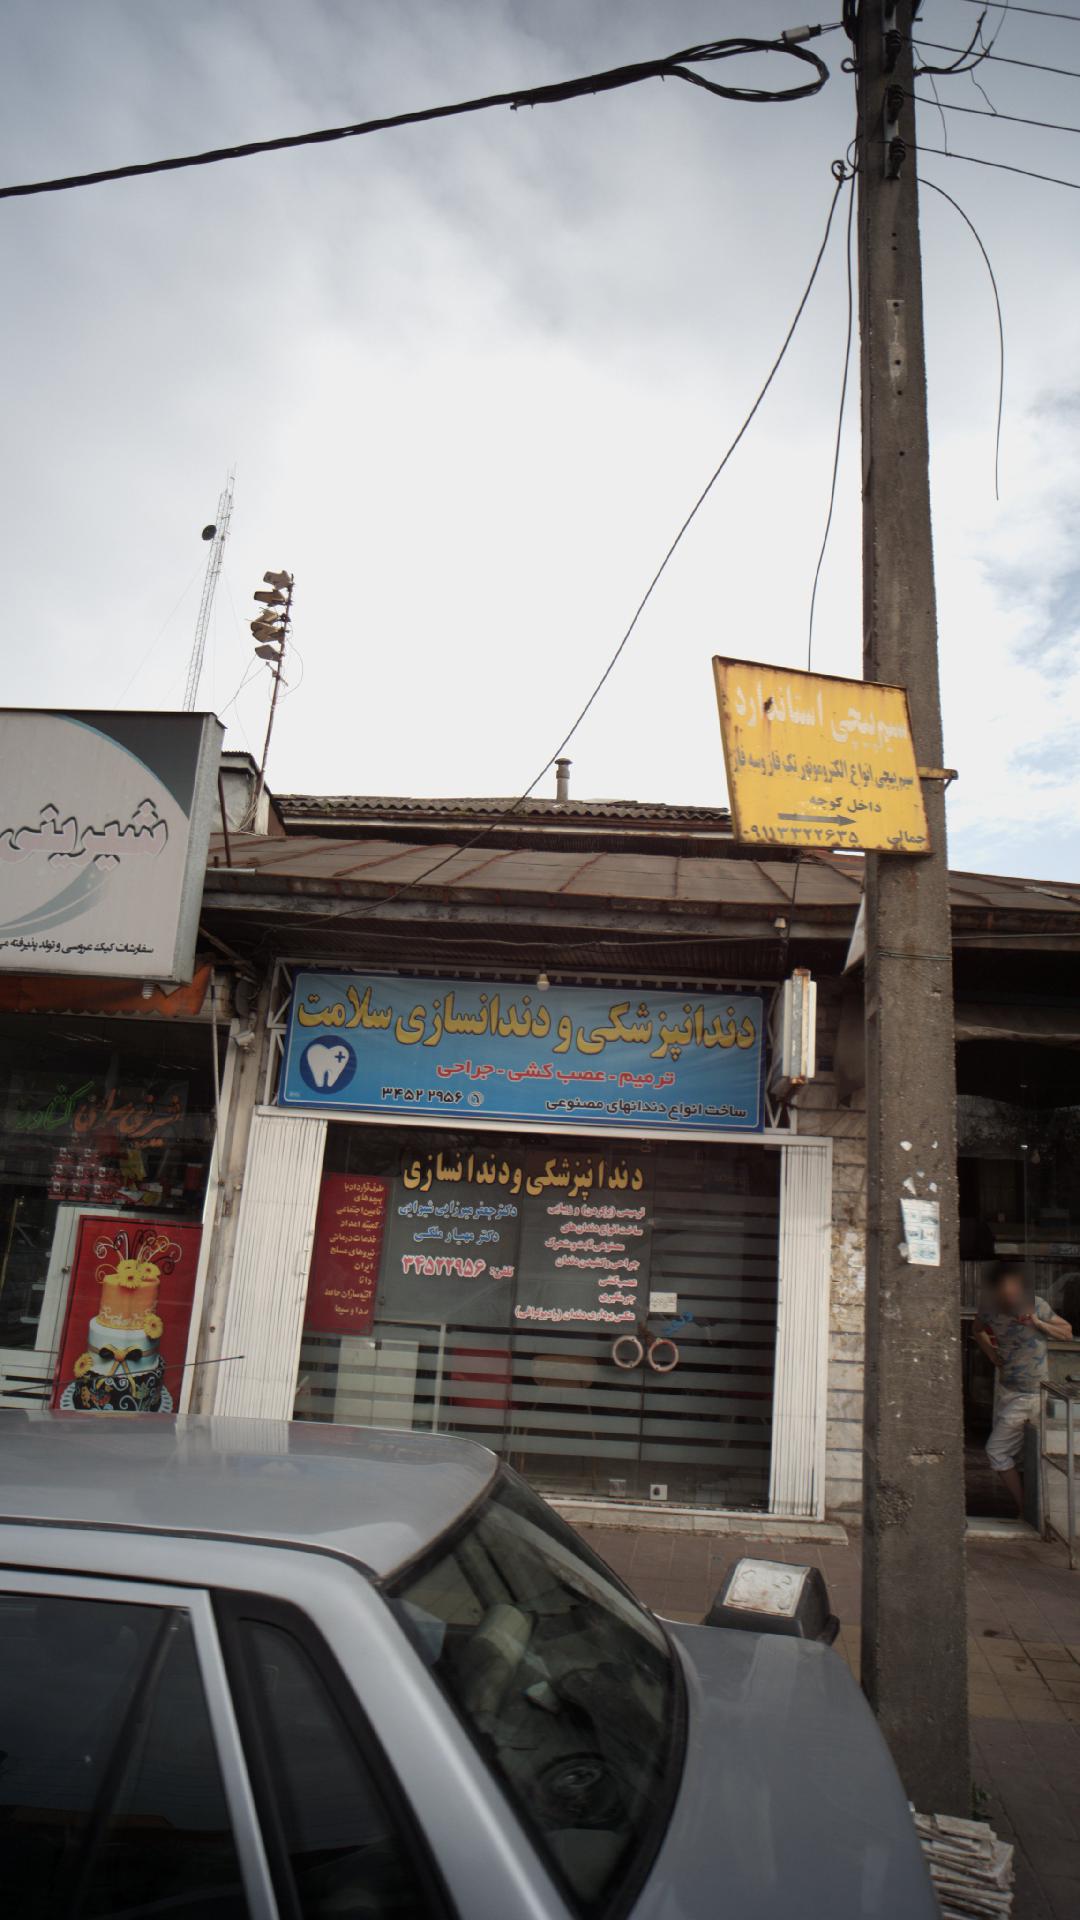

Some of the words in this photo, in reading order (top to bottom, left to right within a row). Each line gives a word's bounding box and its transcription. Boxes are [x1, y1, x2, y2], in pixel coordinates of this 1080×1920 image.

[847, 799, 882, 813] داخل
[886, 830, 927, 846] جمالی
[94, 942, 115, 954] کیک
[116, 943, 154, 955] سفارشات
[297, 985, 392, 1031] سلامت
[394, 991, 551, 1047] دندانسازی
[553, 1020, 570, 1054] و
[576, 999, 756, 1063] دندانپزشکی
[435, 1060, 496, 1081] جراحی
[507, 1062, 553, 1083] کشی
[555, 1066, 606, 1083] عصب
[616, 1068, 677, 1087] ترمیم
[546, 1097, 603, 1111] مصنوعی
[606, 1099, 668, 1115] دندانهای
[668, 1103, 703, 1120] انواع
[704, 1103, 747, 1118] ساخت
[403, 1151, 509, 1191] دندانسازی
[525, 1155, 644, 1200] دندانپزشکی
[495, 1202, 518, 1219] دکتر
[413, 1225, 444, 1242] ملکی
[444, 1226, 475, 1246] مهیار
[476, 1229, 500, 1245] دکتر
[401, 1254, 487, 1277] ۳۴۵۲۲۹۵۶
